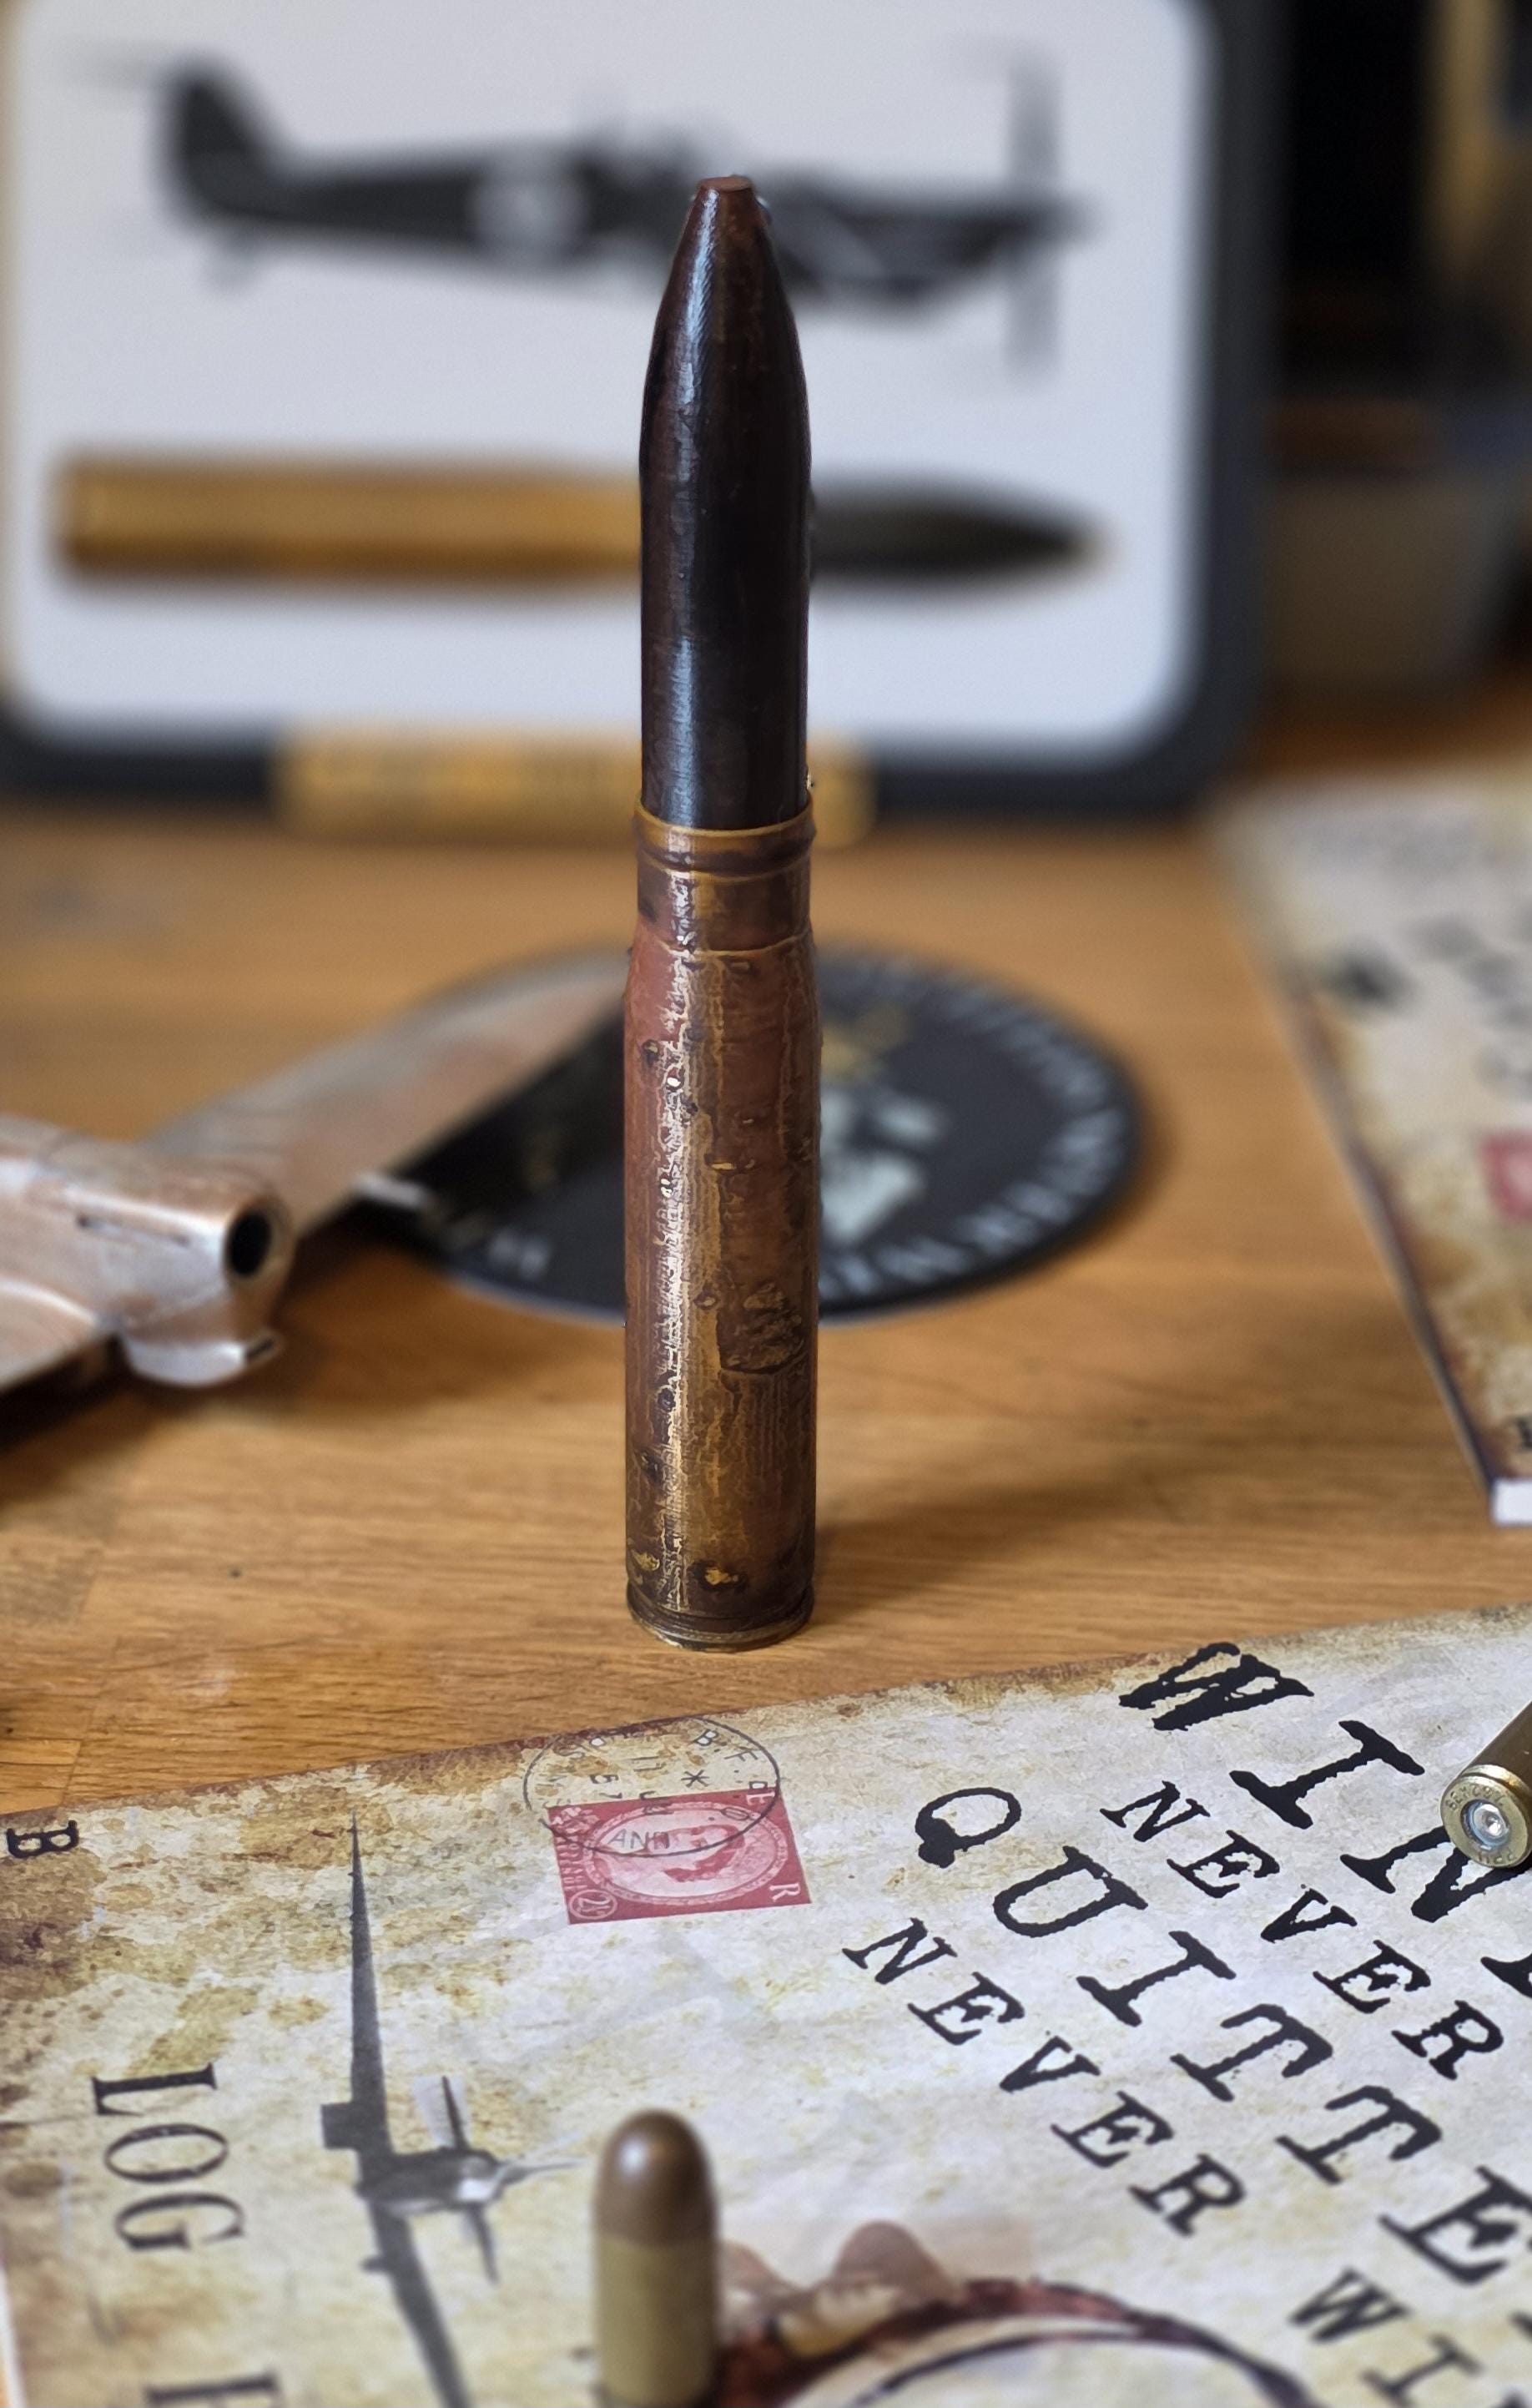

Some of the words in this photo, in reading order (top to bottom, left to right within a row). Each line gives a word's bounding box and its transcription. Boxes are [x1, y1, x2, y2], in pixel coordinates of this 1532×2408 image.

[5, 1820, 79, 1860] B
[769, 1882, 802, 1904] R
[1099, 1779, 1504, 2080] NEVER
[1118, 1641, 1532, 1999] WIN
[91, 2062, 248, 2251] LOG
[841, 1918, 1244, 2235] NEVER
[1288, 2265, 1532, 2408] WI
[915, 1786, 1532, 2358] QUITTE
